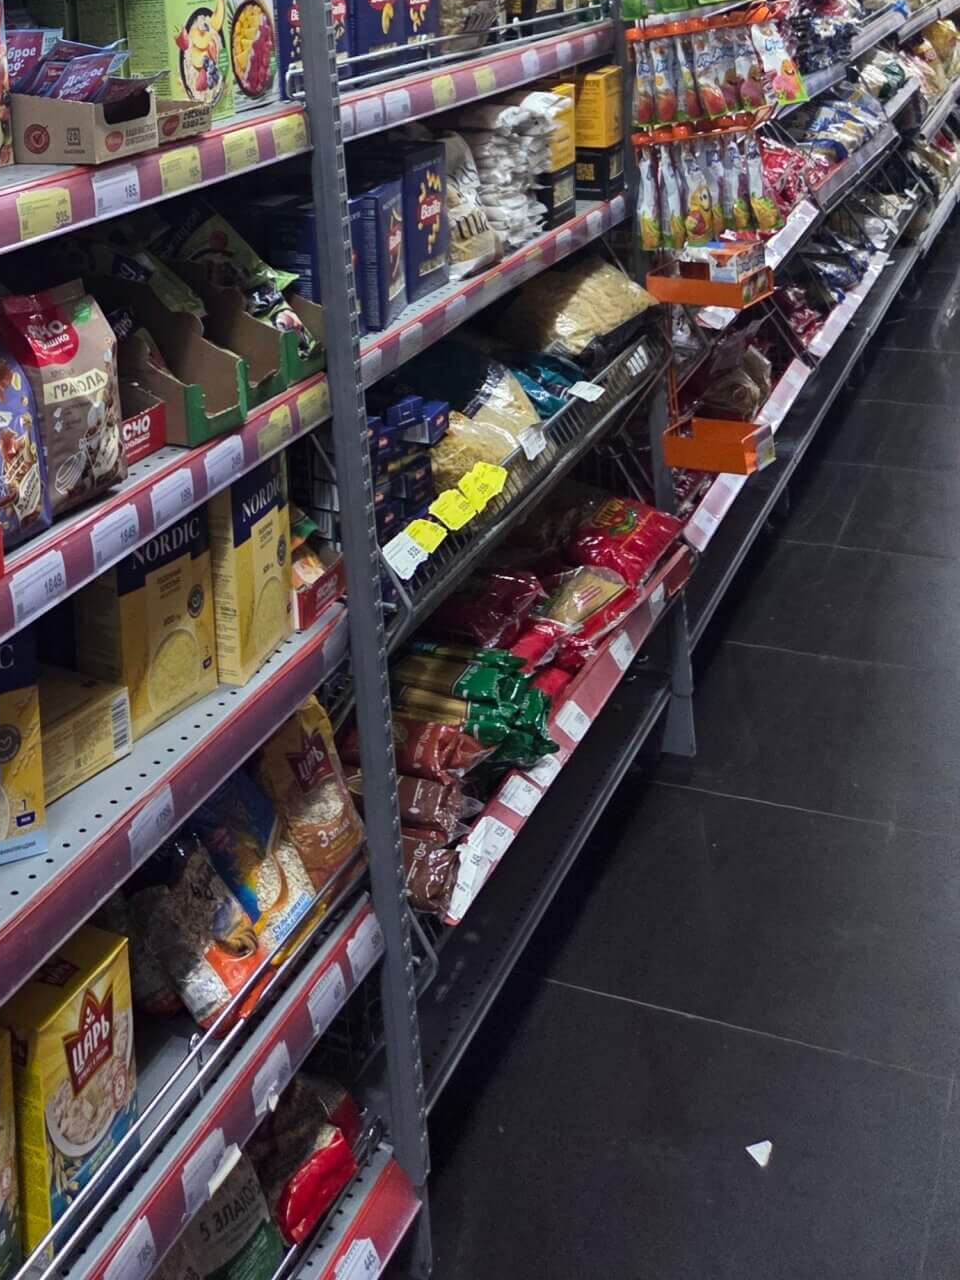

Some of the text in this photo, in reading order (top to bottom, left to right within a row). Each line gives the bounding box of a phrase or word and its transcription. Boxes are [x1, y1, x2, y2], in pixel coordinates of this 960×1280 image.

[242, 475, 282, 522] NORDIC
[133, 516, 200, 571] NORDIC
[318, 828, 329, 848] 3
[72, 1016, 110, 1073] ЦАРЬ
[200, 1223, 211, 1242] 5
